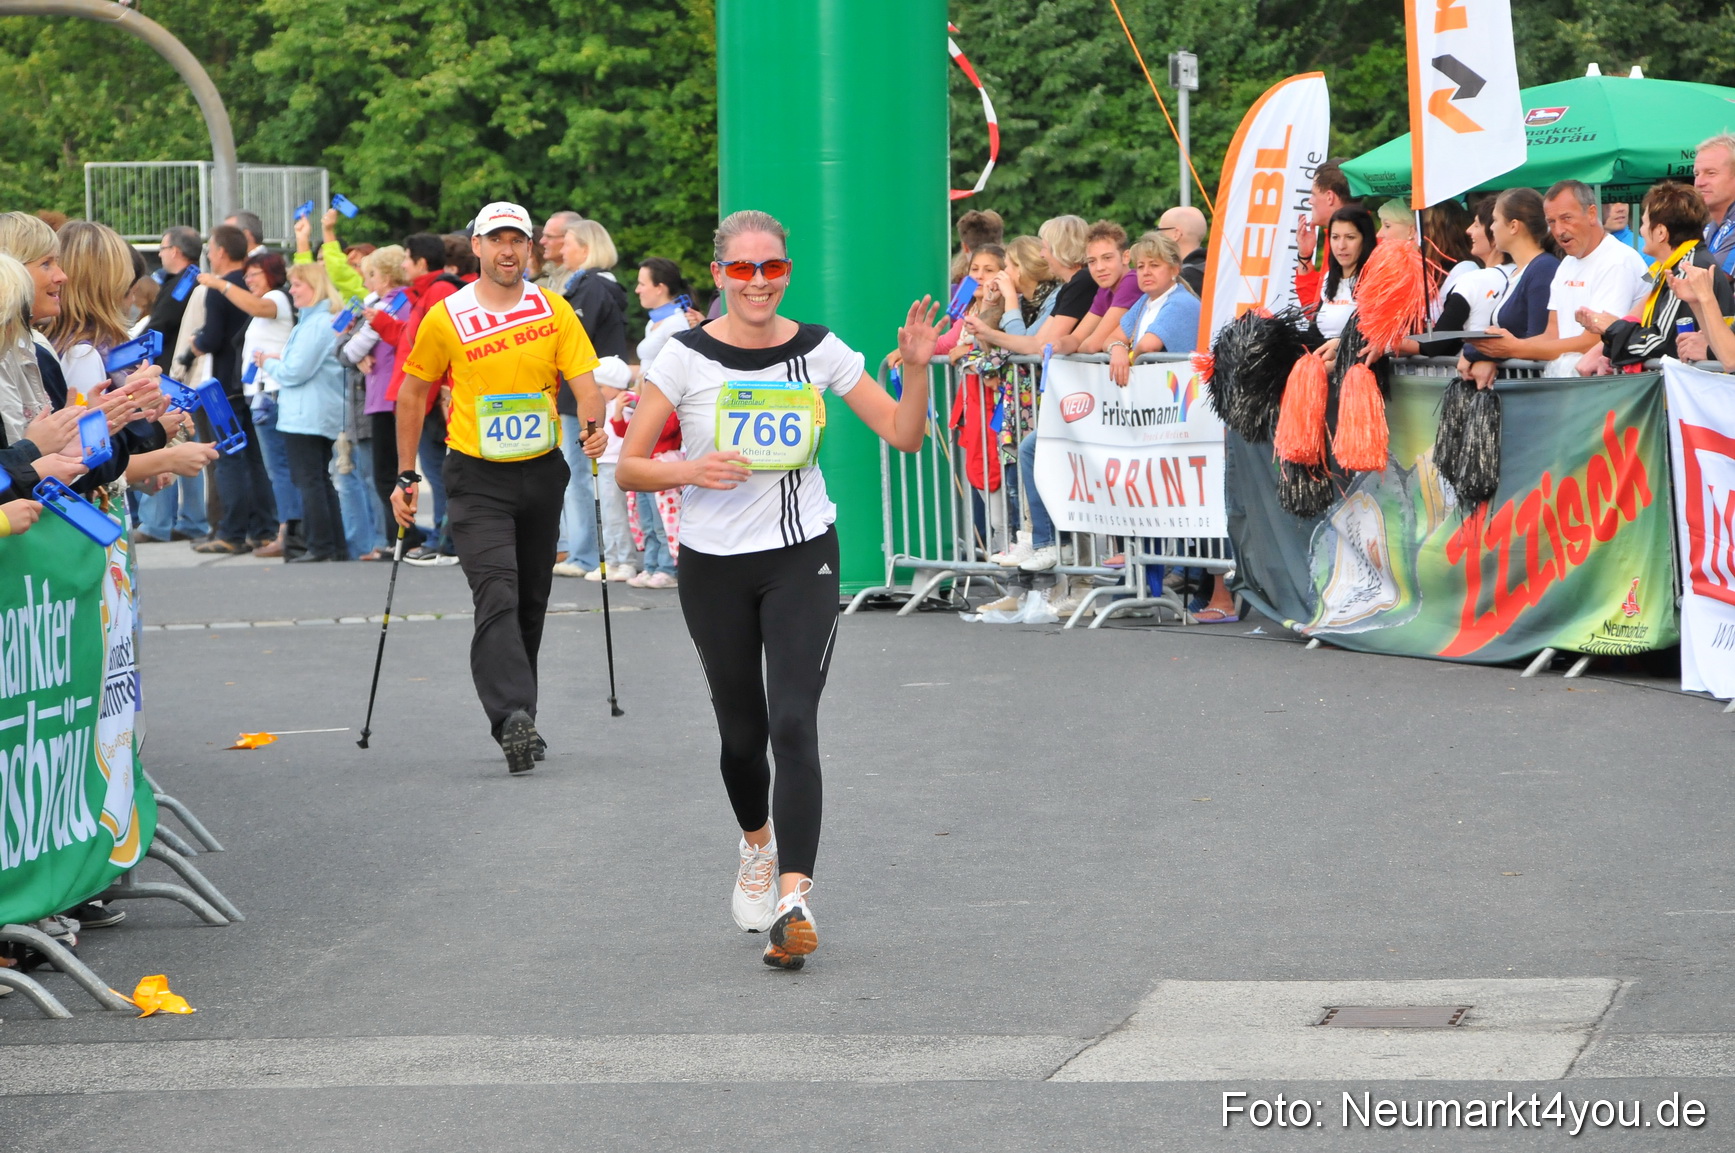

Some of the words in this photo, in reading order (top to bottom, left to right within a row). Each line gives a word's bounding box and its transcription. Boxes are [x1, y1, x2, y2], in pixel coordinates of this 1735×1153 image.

[1681, 150, 1697, 160] Ne
[465, 338, 509, 363] MAX
[513, 321, 558, 346] BÖGL
[1063, 402, 1089, 416] NEU!
[1102, 401, 1179, 427] Frischmann
[486, 413, 541, 442] 402
[728, 411, 802, 447] 766
[742, 447, 771, 456] Kheira
[1068, 452, 1207, 508] XL-PRINT
[1068, 511, 1211, 528] WWWFRISCHMANN-NET.DE
